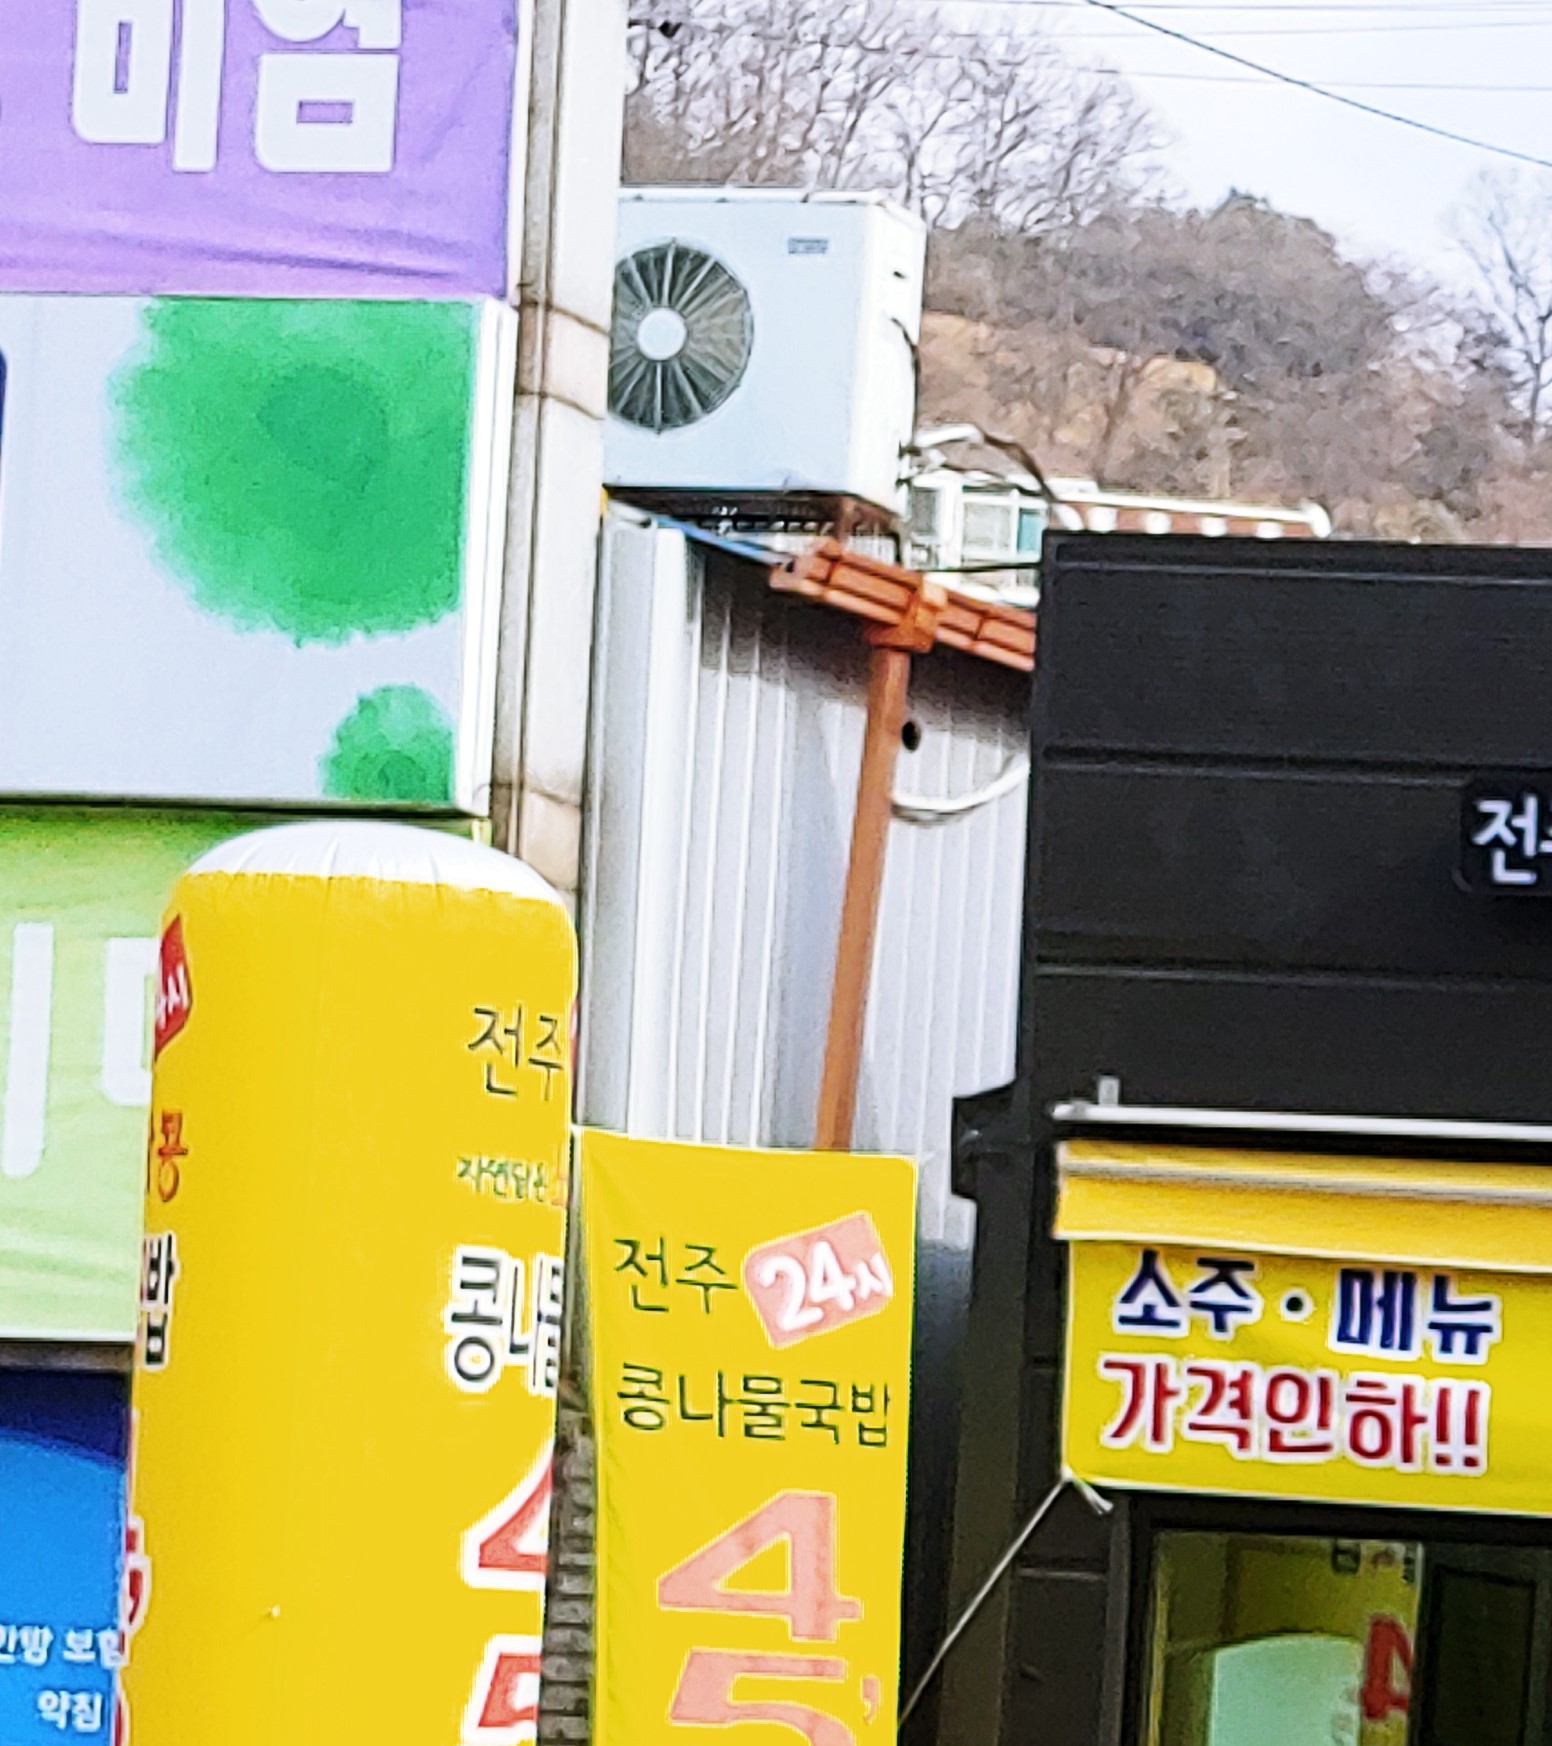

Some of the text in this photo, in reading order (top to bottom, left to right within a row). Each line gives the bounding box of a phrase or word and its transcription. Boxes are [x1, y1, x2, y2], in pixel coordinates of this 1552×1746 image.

[468, 1005, 566, 1101] 전주
[613, 1237, 738, 1315] 전주
[617, 1363, 890, 1448] 콩나물국밥
[1103, 1359, 1480, 1469] 가격인하!!
